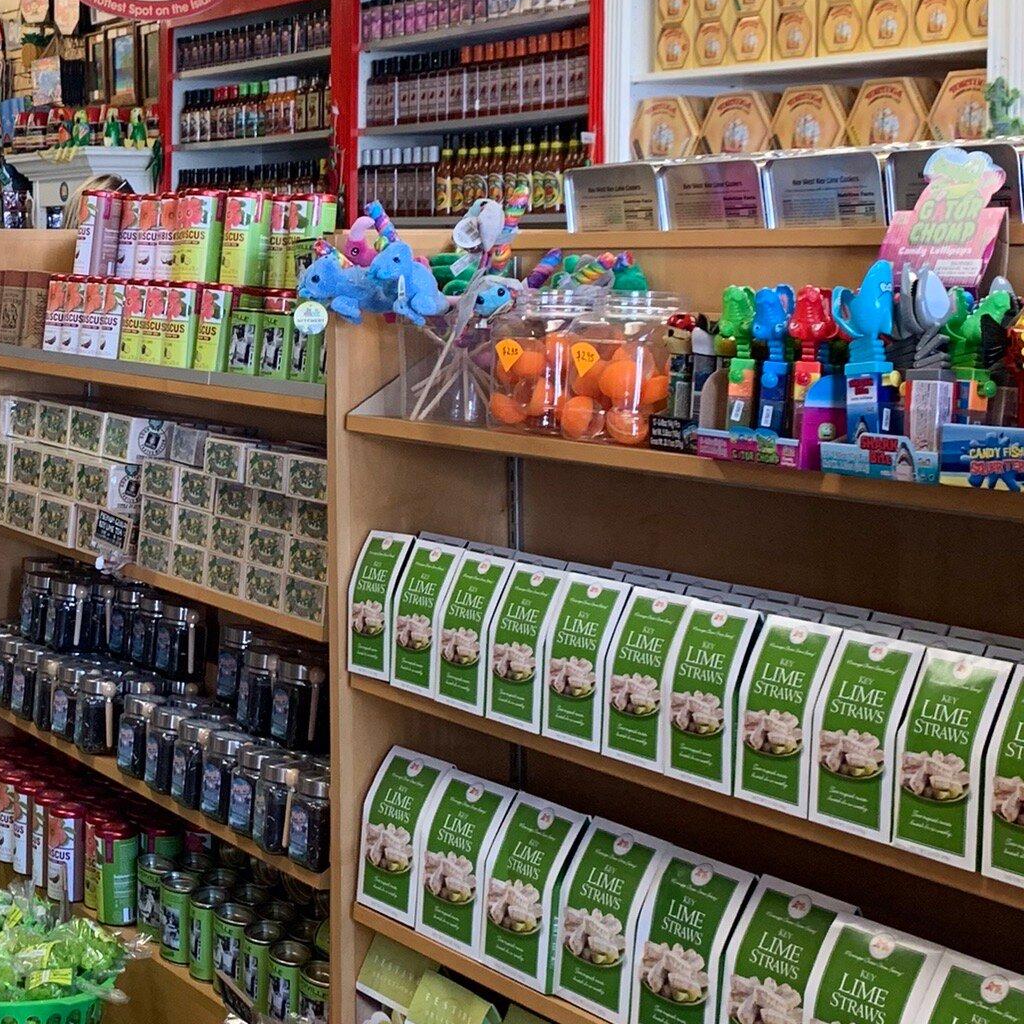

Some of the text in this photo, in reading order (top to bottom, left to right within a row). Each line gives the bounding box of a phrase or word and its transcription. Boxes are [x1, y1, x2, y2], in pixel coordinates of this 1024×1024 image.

[128, 4, 154, 17] Spot
[156, 7, 170, 16] on
[171, 3, 190, 15] the
[860, 434, 899, 452] SHARK
[969, 446, 1002, 459] CANDY
[362, 565, 388, 583] LIME
[357, 580, 387, 594] STRAWS
[408, 577, 437, 596] LIME
[403, 591, 434, 608] STRAWS
[454, 589, 485, 610] LIME
[448, 605, 483, 622] STRAWS
[506, 602, 540, 623] LIME
[578, 611, 589, 619] KEY
[500, 618, 538, 637] STRAWS
[562, 614, 599, 638] LIME
[642, 626, 655, 634] KEY
[556, 630, 597, 652] STRAWS
[626, 630, 665, 654] LIME
[702, 641, 715, 649] KEY
[618, 647, 661, 668] STRAWS
[684, 645, 726, 670] LIME
[779, 658, 794, 668] KEY
[679, 663, 724, 686] STRAWS
[761, 662, 806, 689] LIME
[858, 676, 875, 686] KEY
[753, 680, 804, 705] STRAWS
[838, 680, 887, 708] LIME
[941, 695, 958, 705] KEY
[830, 698, 885, 724] STRAWS
[920, 699, 972, 728] LIME
[913, 719, 970, 745] STRAWS
[384, 788, 414, 811] LIME
[377, 803, 411, 824] STRAWS
[443, 814, 476, 839] LIME
[436, 829, 473, 853] STRAWS
[512, 841, 545, 867] LIME
[506, 857, 541, 881] STRAWS
[587, 866, 625, 896] LIME
[579, 883, 623, 911] STRAWS
[682, 895, 695, 906] KEY
[668, 899, 706, 930] LIME
[661, 916, 704, 946] STRAWS
[777, 928, 794, 940] KEY
[757, 931, 804, 964] LIME
[749, 948, 800, 982] STRAWS
[859, 969, 877, 981] KEY
[838, 972, 890, 1008] LIME
[829, 991, 887, 1024] STRAWS
